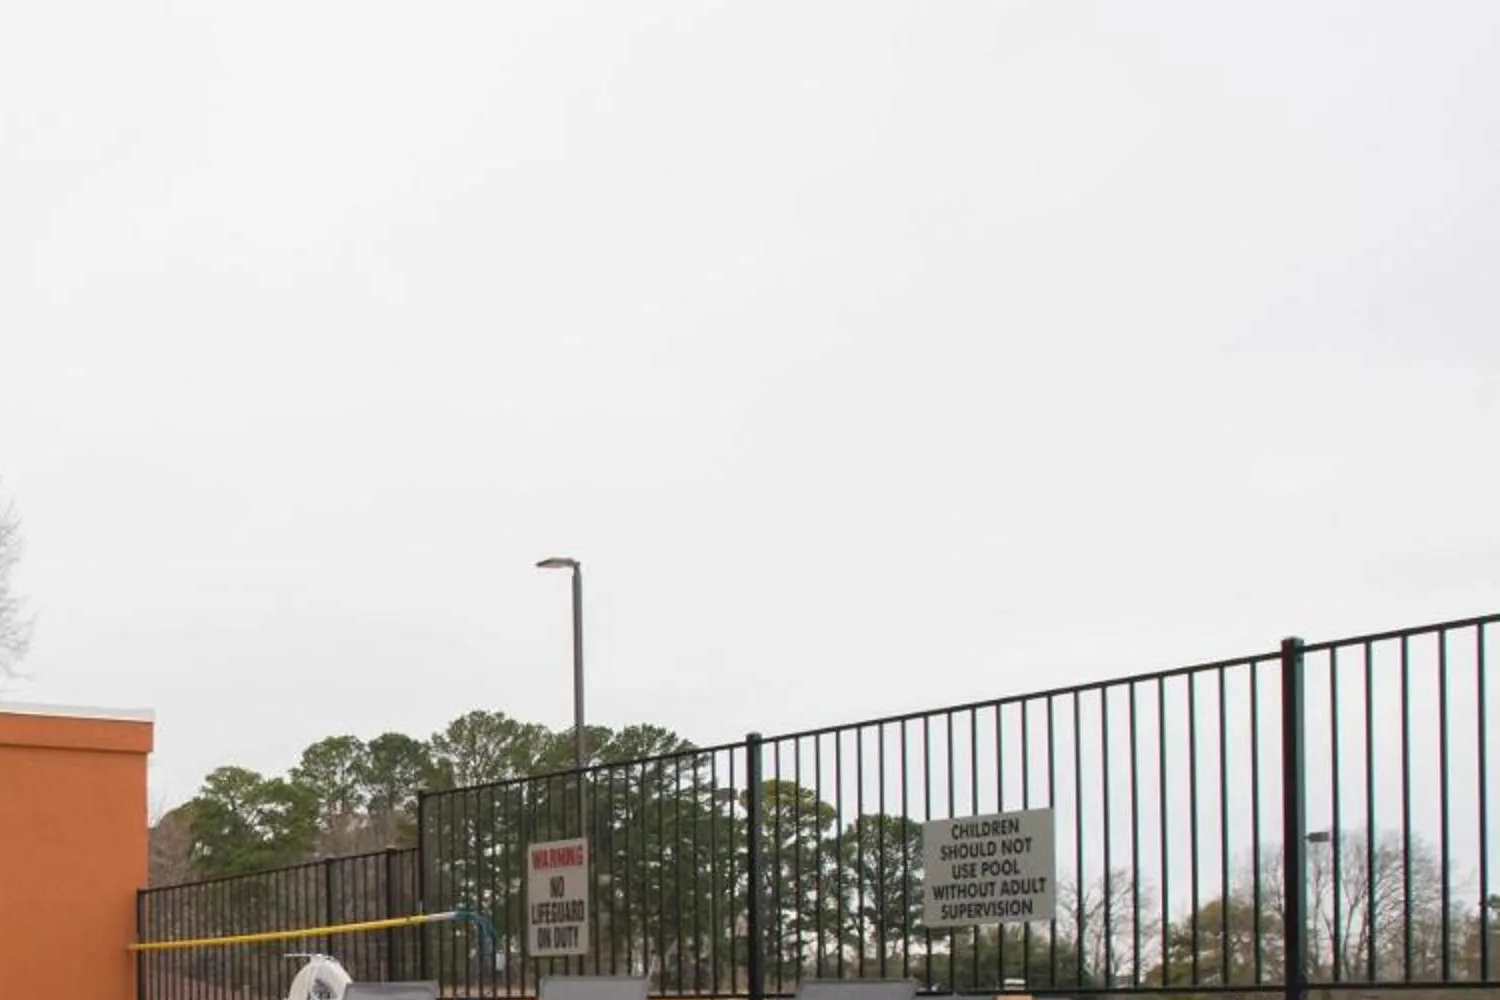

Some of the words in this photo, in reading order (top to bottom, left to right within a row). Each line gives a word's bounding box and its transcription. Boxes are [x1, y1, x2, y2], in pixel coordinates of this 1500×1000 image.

[951, 818, 1019, 840] CHILDREN
[532, 845, 584, 870] WARNING
[940, 841, 997, 861] SHOULD
[1001, 837, 1032, 855] NOT
[951, 862, 978, 880] USE
[981, 859, 1021, 877] POOL
[549, 875, 565, 898] NO
[932, 881, 996, 900] WITHOUT
[1000, 877, 1047, 897] ADULT
[531, 899, 585, 925] LIFEGUARD
[940, 899, 1033, 920] SUPERVISION
[538, 927, 551, 949] ON
[554, 926, 579, 949] DUTY
